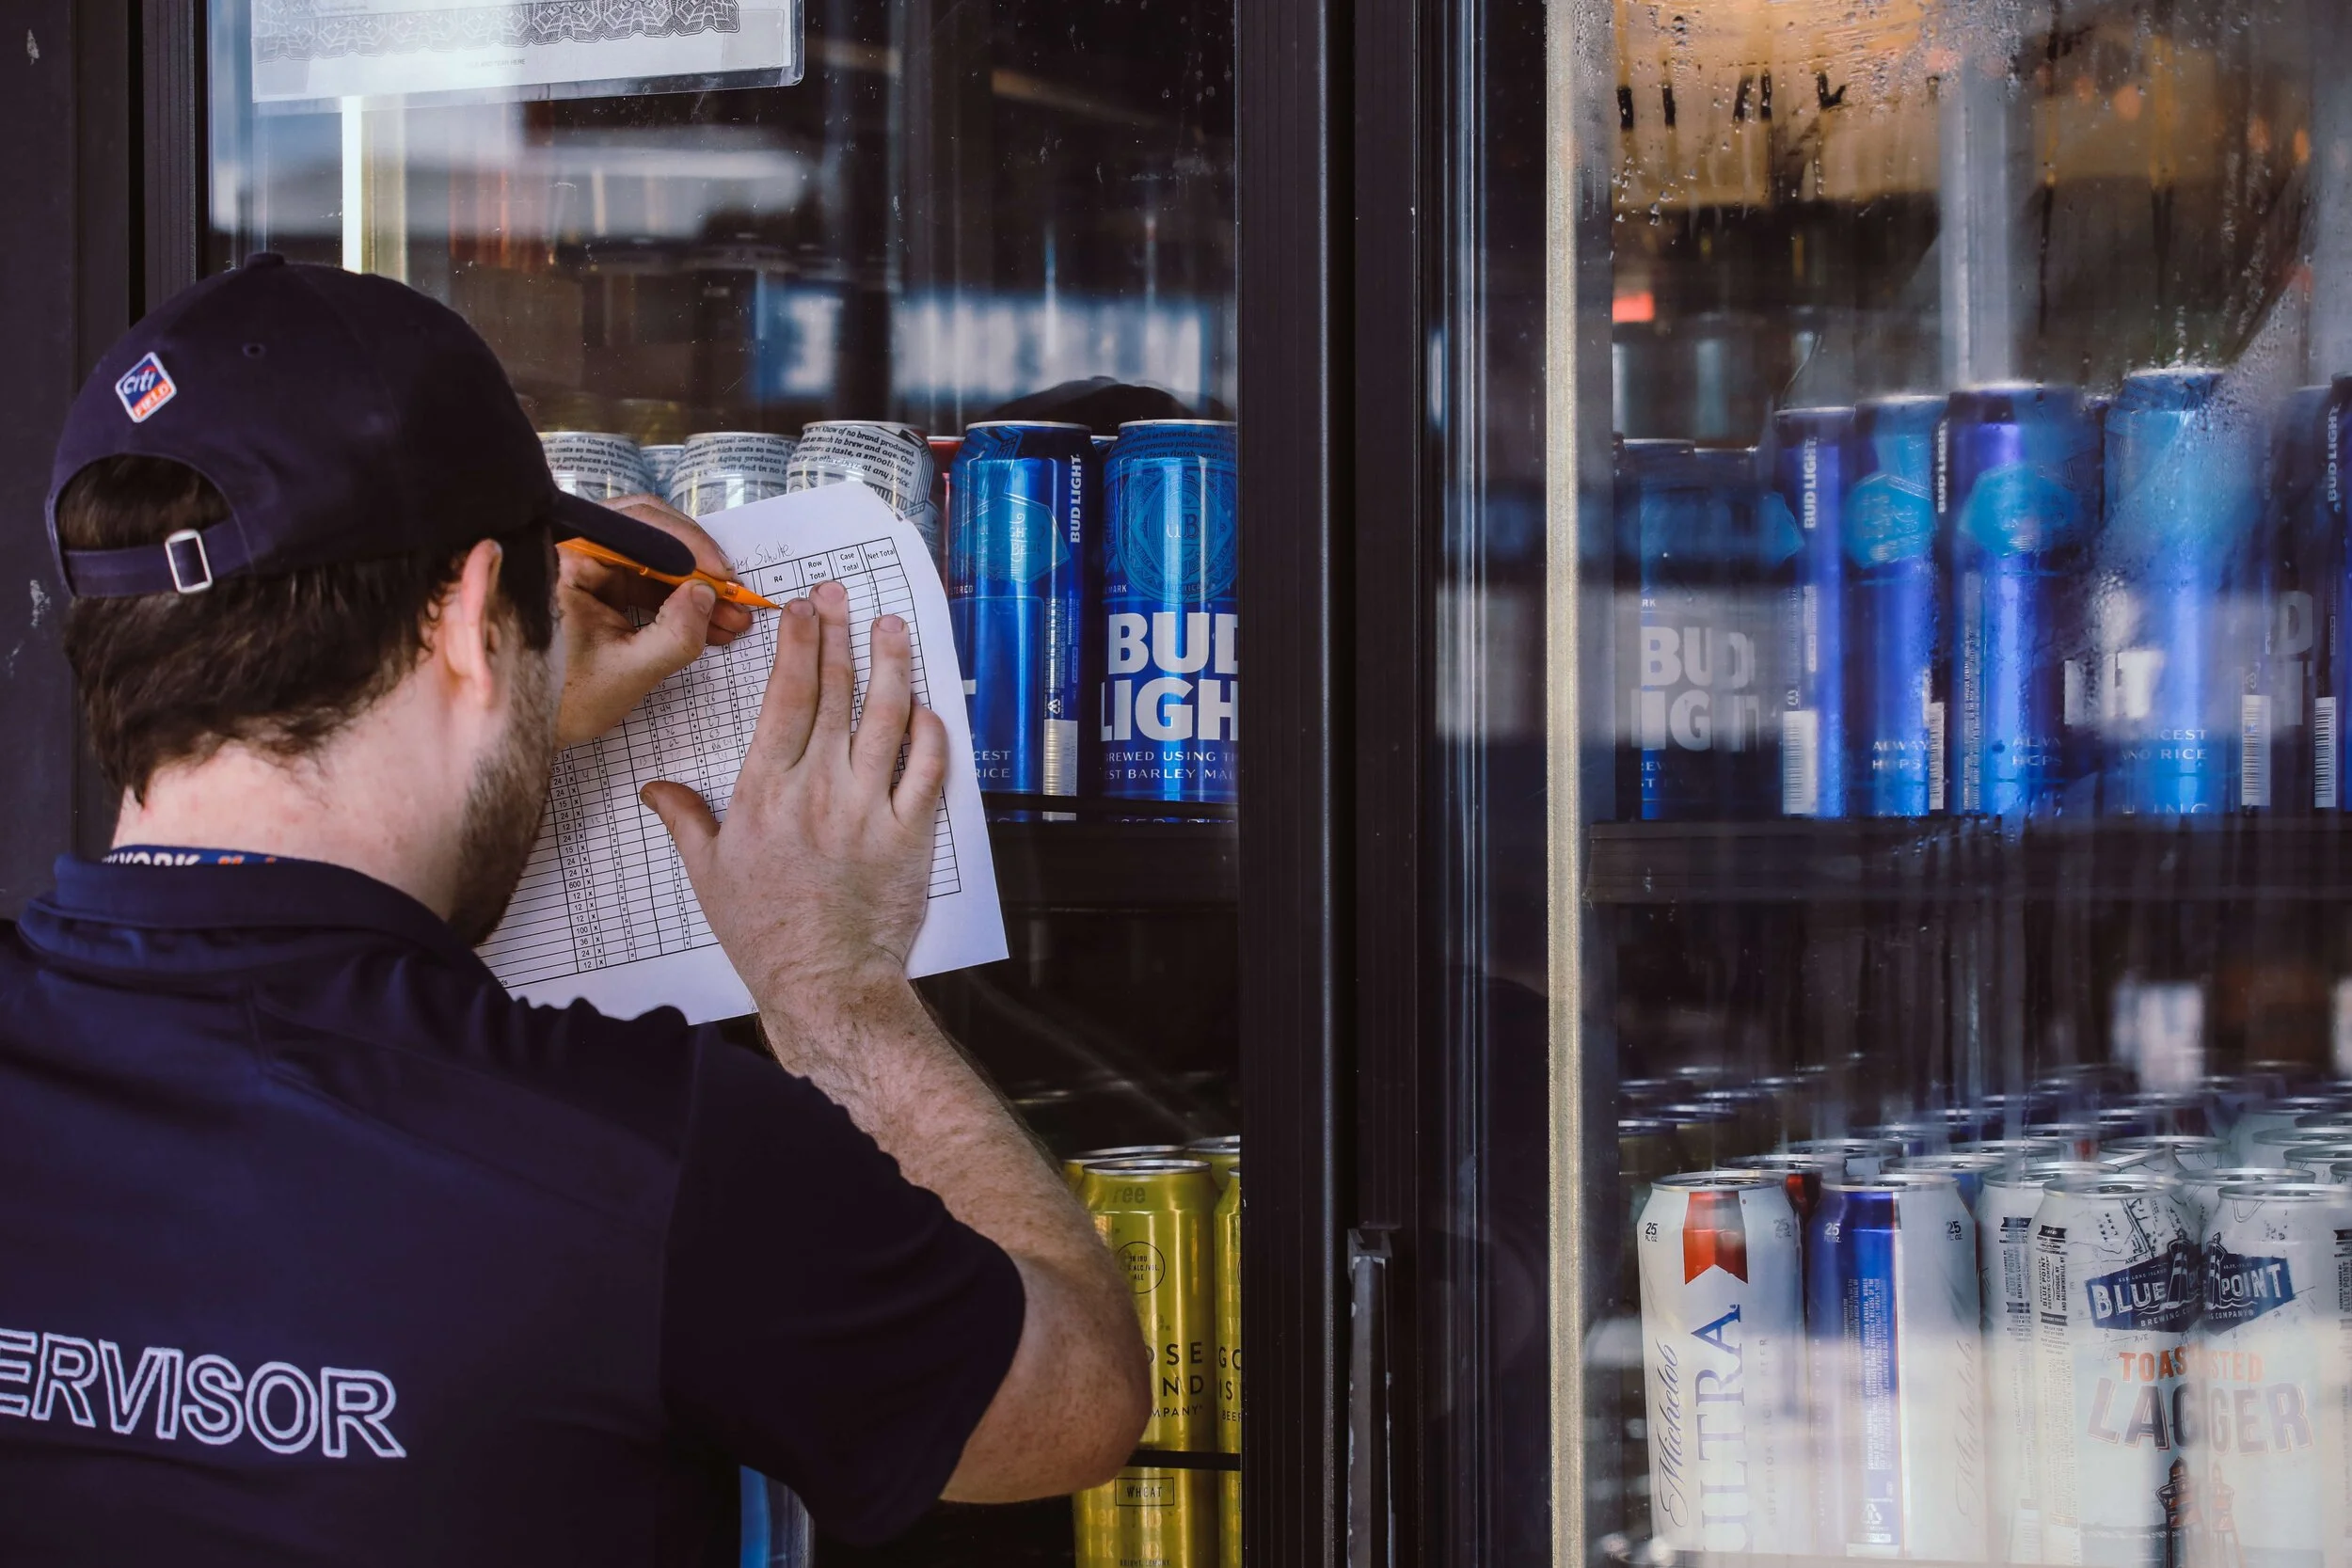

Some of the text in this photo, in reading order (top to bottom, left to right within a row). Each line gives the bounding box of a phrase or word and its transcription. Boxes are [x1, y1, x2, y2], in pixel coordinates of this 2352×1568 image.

[847, 429, 856, 437] no
[857, 432, 880, 444] brand
[881, 439, 914, 457] produced
[844, 439, 864, 449] brew
[865, 443, 881, 453] and
[882, 449, 899, 461] age.
[900, 455, 915, 467] Our
[718, 454, 782, 465] Aging produces
[832, 446, 854, 458] taste,
[863, 453, 914, 478] smoothness
[862, 464, 871, 472] at
[872, 466, 890, 481] any
[890, 472, 911, 489] price.
[2327, 460, 2337, 502] BUD
[1804, 436, 1818, 529] BUD LIGHT
[1070, 454, 1082, 544] BUD LIGHT
[1938, 475, 1948, 514] BUD
[839, 552, 855, 561] Case
[867, 547, 896, 561] Net Total
[807, 560, 822, 568] Row
[843, 563, 860, 572] Total
[773, 575, 783, 583] R4
[810, 572, 827, 580] Total
[1163, 751, 1216, 761] USING
[2161, 749, 2208, 760] RICE
[1128, 768, 1196, 779] BARLEY
[554, 777, 563, 785] 24
[556, 788, 564, 797] 24
[561, 812, 569, 820] 24
[567, 857, 576, 865] 24
[568, 880, 581, 889] 600
[573, 892, 581, 900] 12
[574, 903, 582, 911] 12
[576, 914, 584, 923] 12
[1644, 1222, 1658, 1235] 25
[1824, 1220, 1840, 1236] 25
[1946, 1220, 1961, 1235] 25
[2221, 1263, 2281, 1300] POINT
[2090, 1281, 2167, 1320] BLUE
[2140, 1311, 2181, 1327] BREWING
[1654, 1338, 1689, 1528] Michelob
[1127, 1486, 1163, 1498] WHEAT
